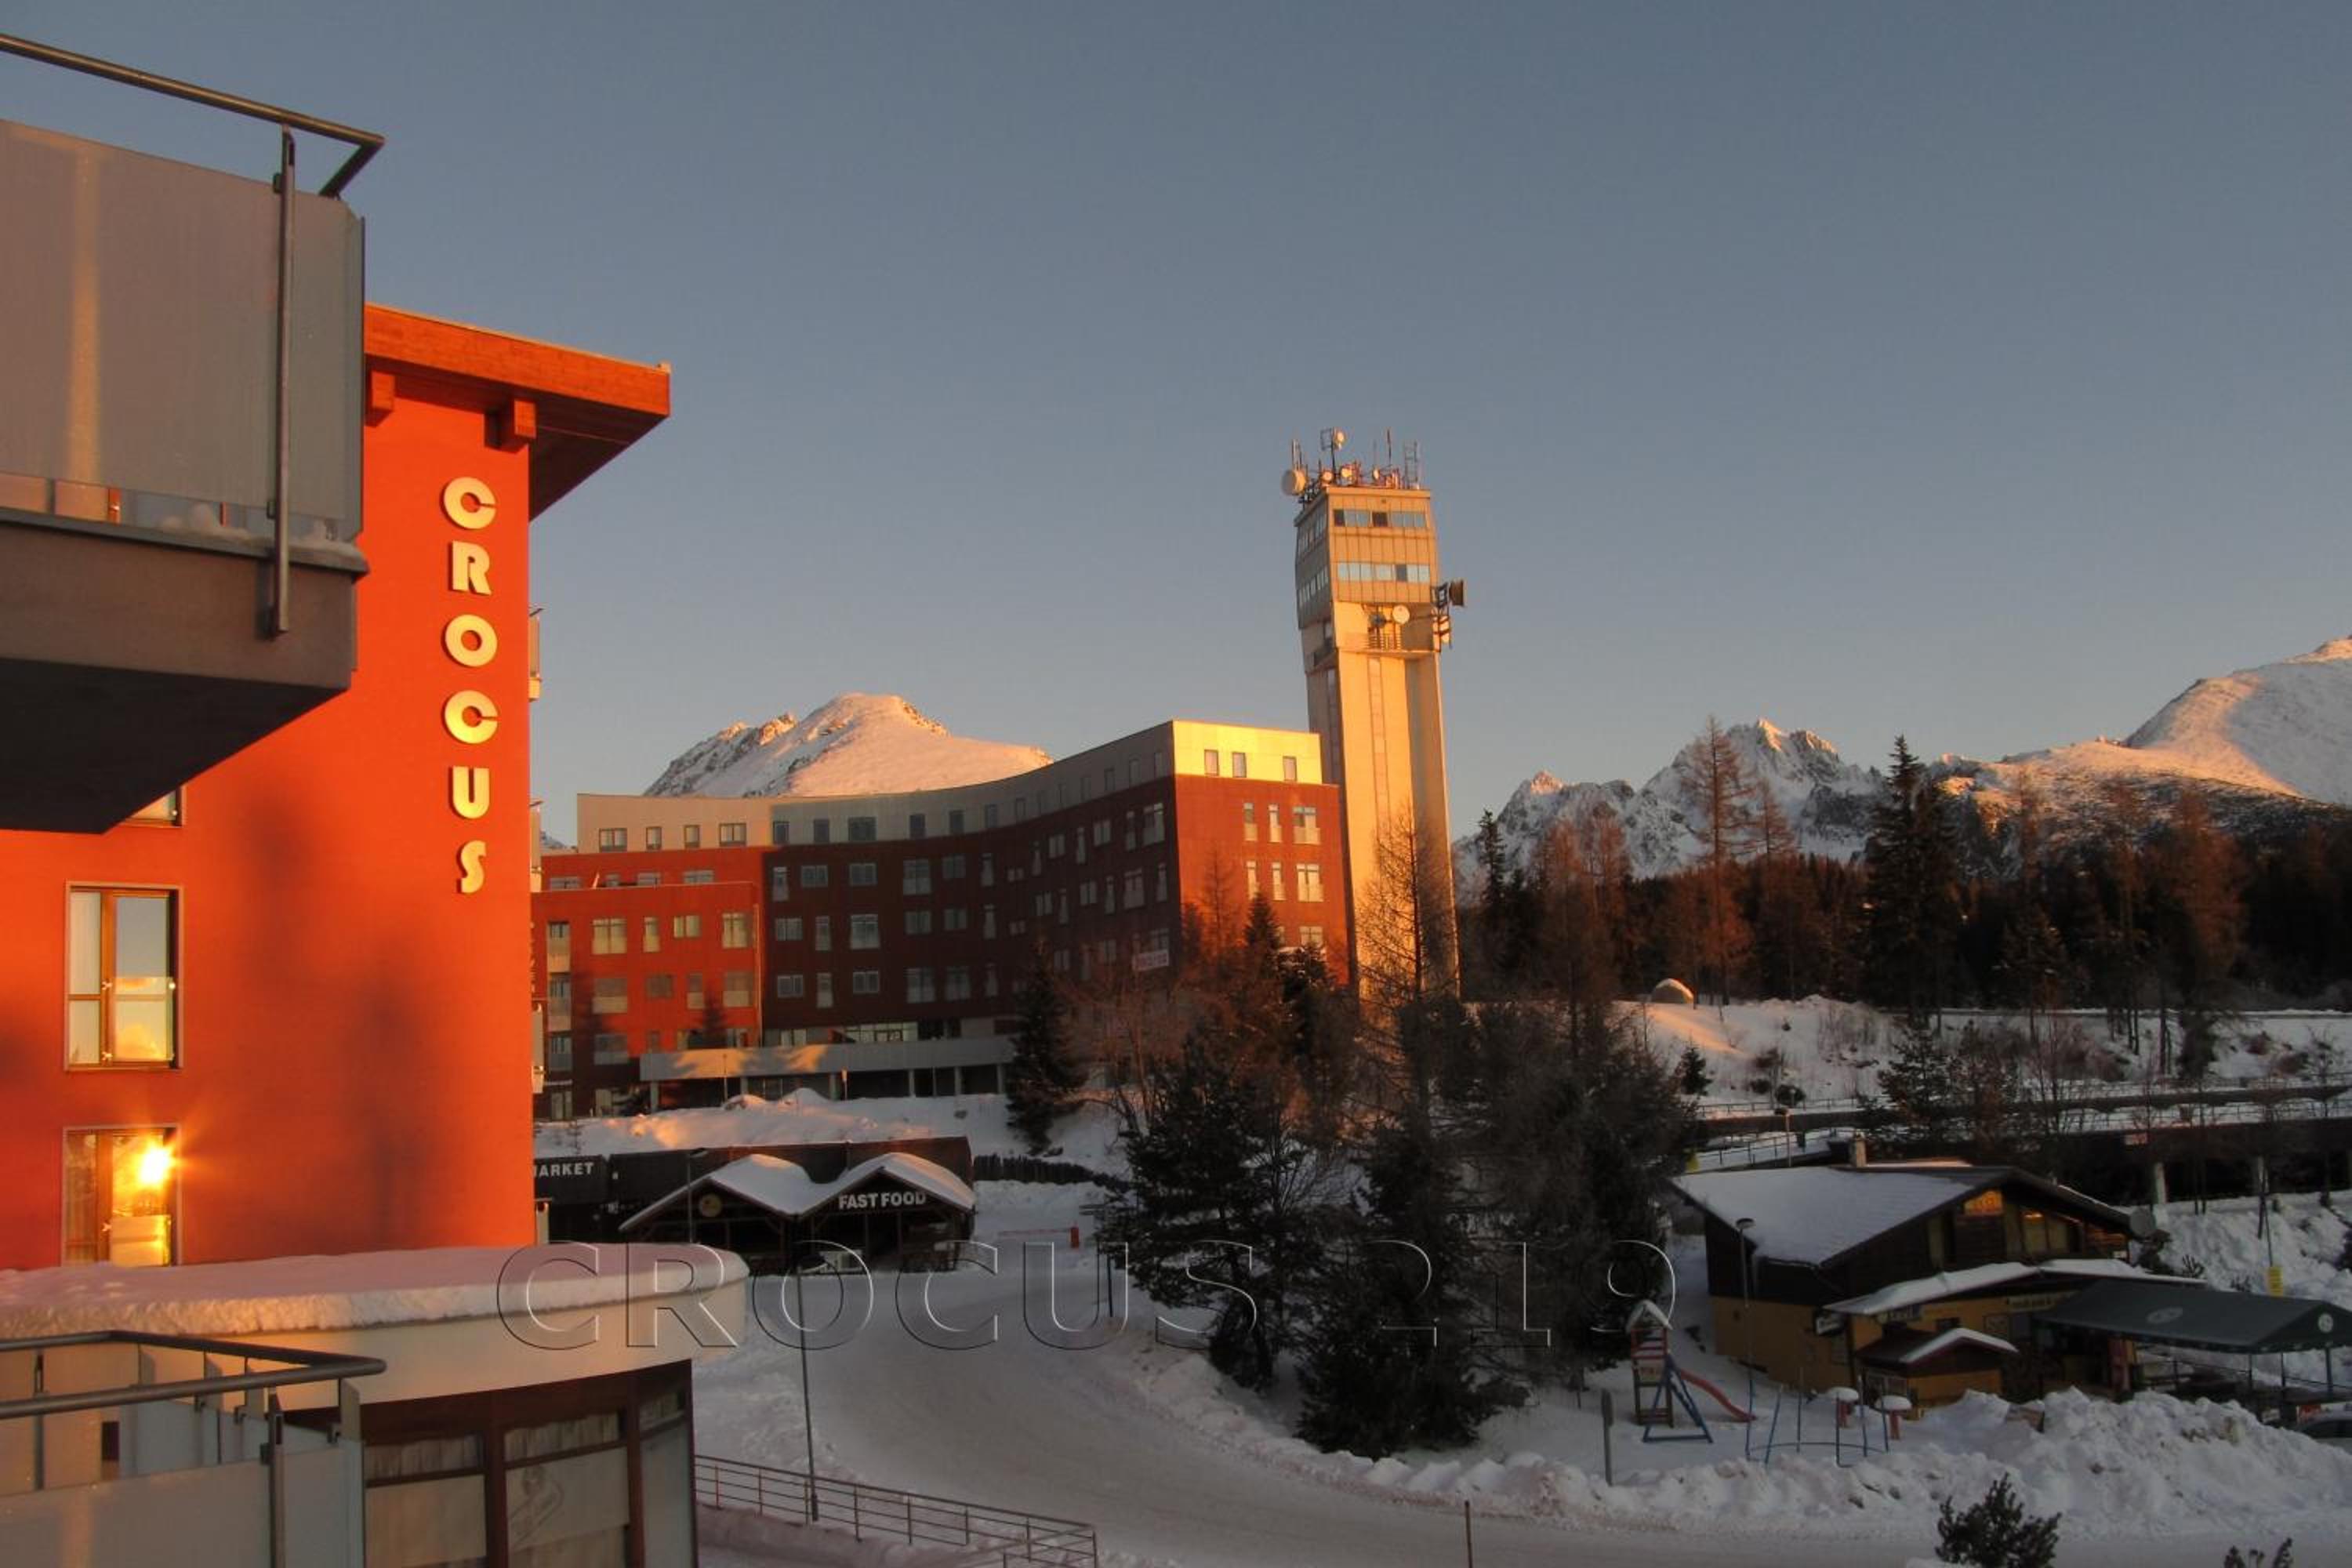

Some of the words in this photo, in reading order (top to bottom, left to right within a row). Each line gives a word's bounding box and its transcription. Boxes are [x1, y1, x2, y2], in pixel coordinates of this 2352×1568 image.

[442, 475, 498, 894] CROCUS
[838, 1193, 878, 1210] FAST
[880, 1191, 926, 1207] FOOD
